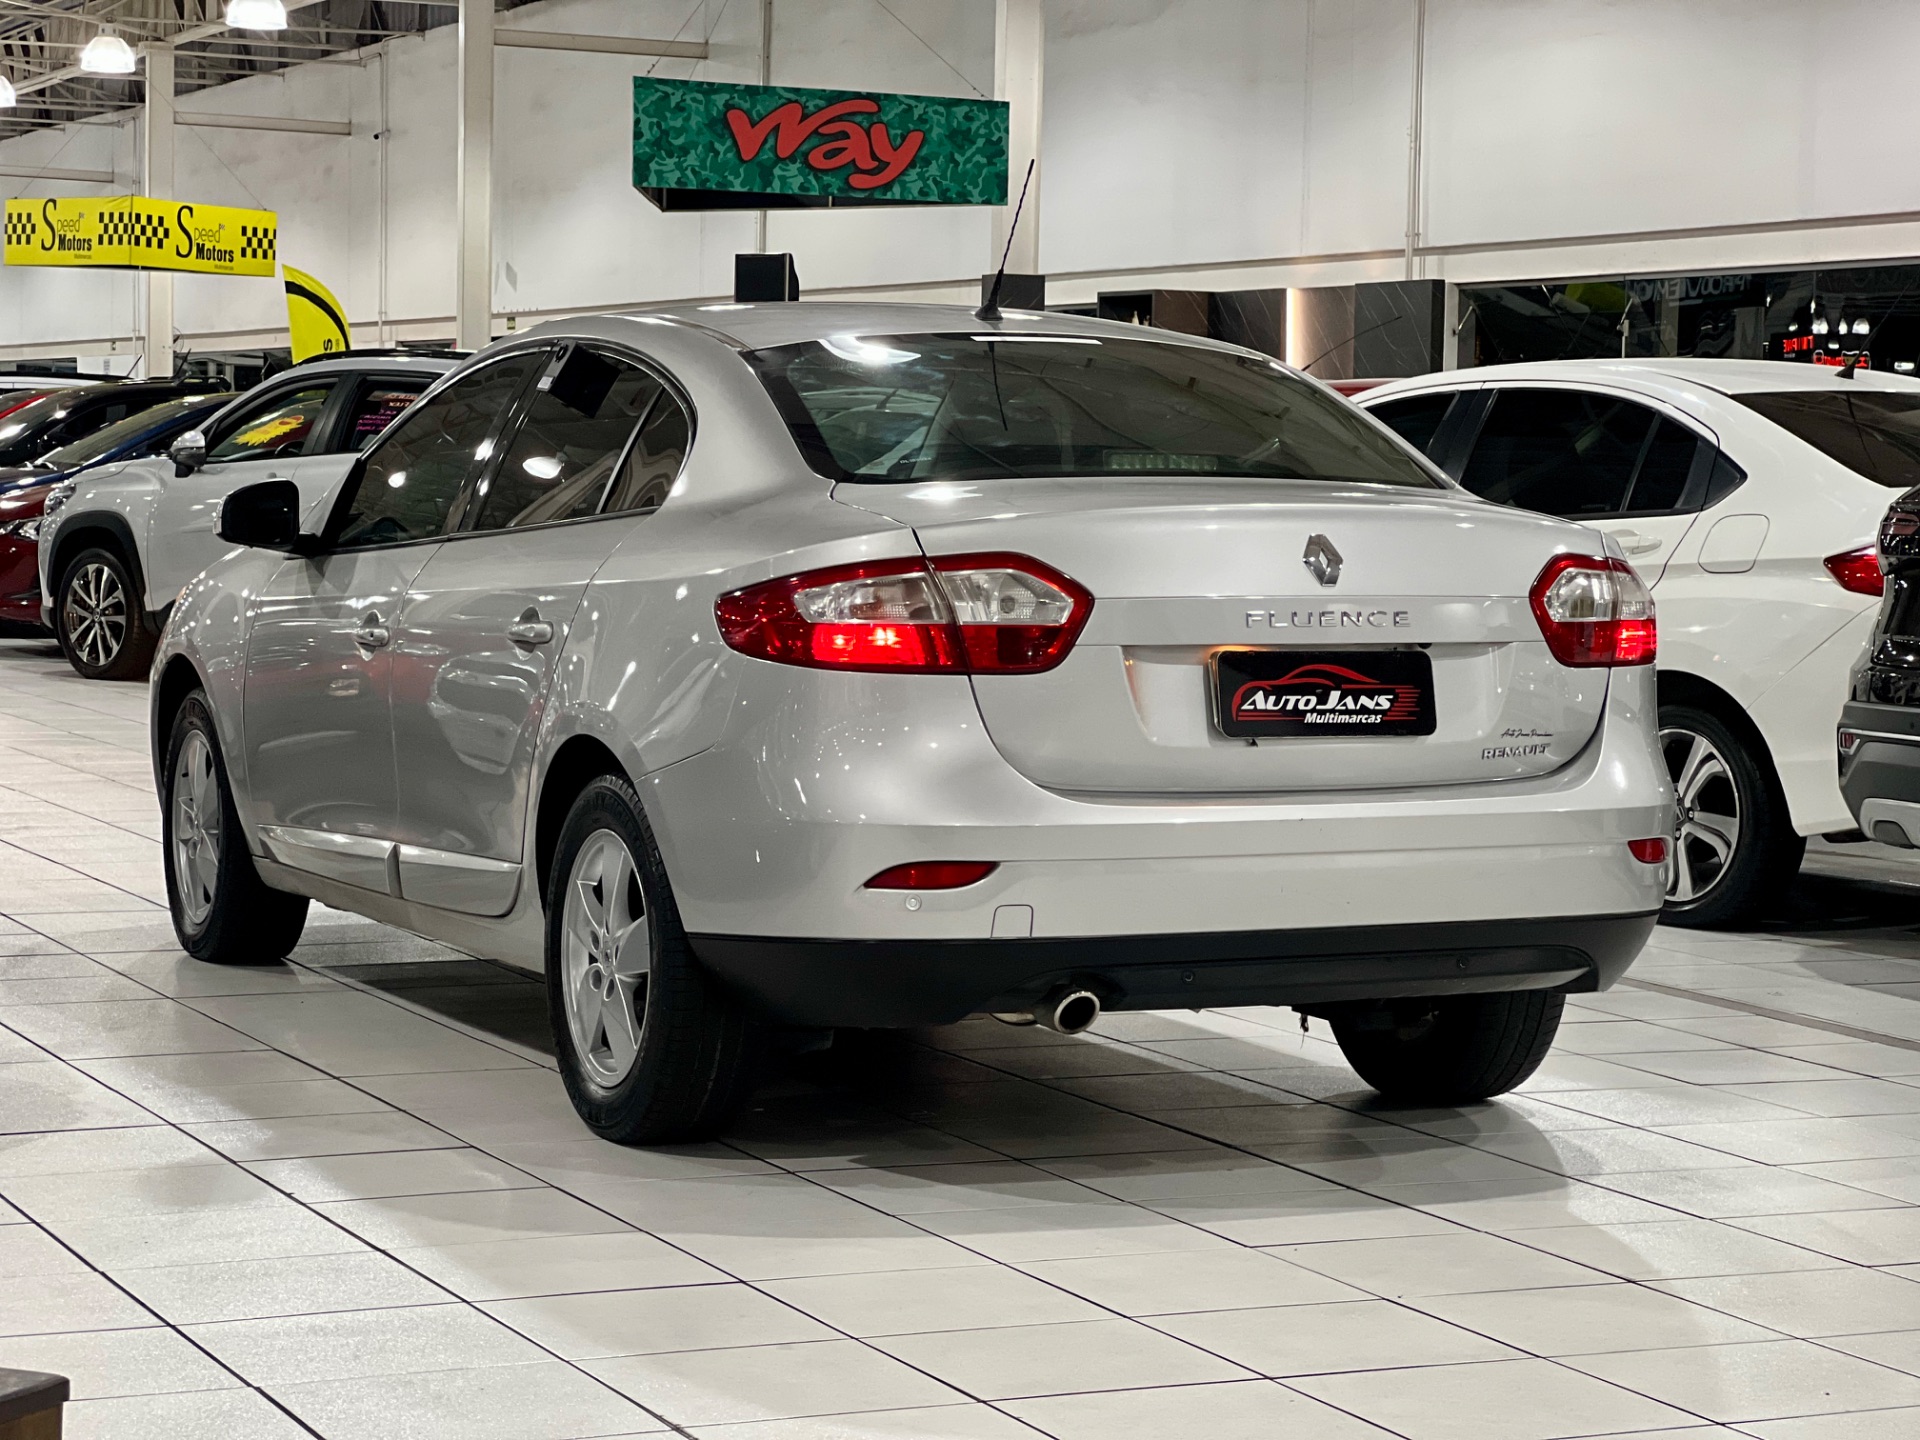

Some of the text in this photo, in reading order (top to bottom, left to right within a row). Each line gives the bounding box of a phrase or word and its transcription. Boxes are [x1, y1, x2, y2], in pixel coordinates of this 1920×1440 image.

[725, 99, 924, 189] Way
[41, 198, 81, 251] Speed
[175, 205, 221, 258] Speed
[57, 234, 92, 251] Motors
[195, 242, 235, 262] Motors
[1245, 610, 1411, 628] FLUENCE
[1304, 712, 1382, 725] Multimarcas
[1481, 742, 1551, 760] RENAULT
